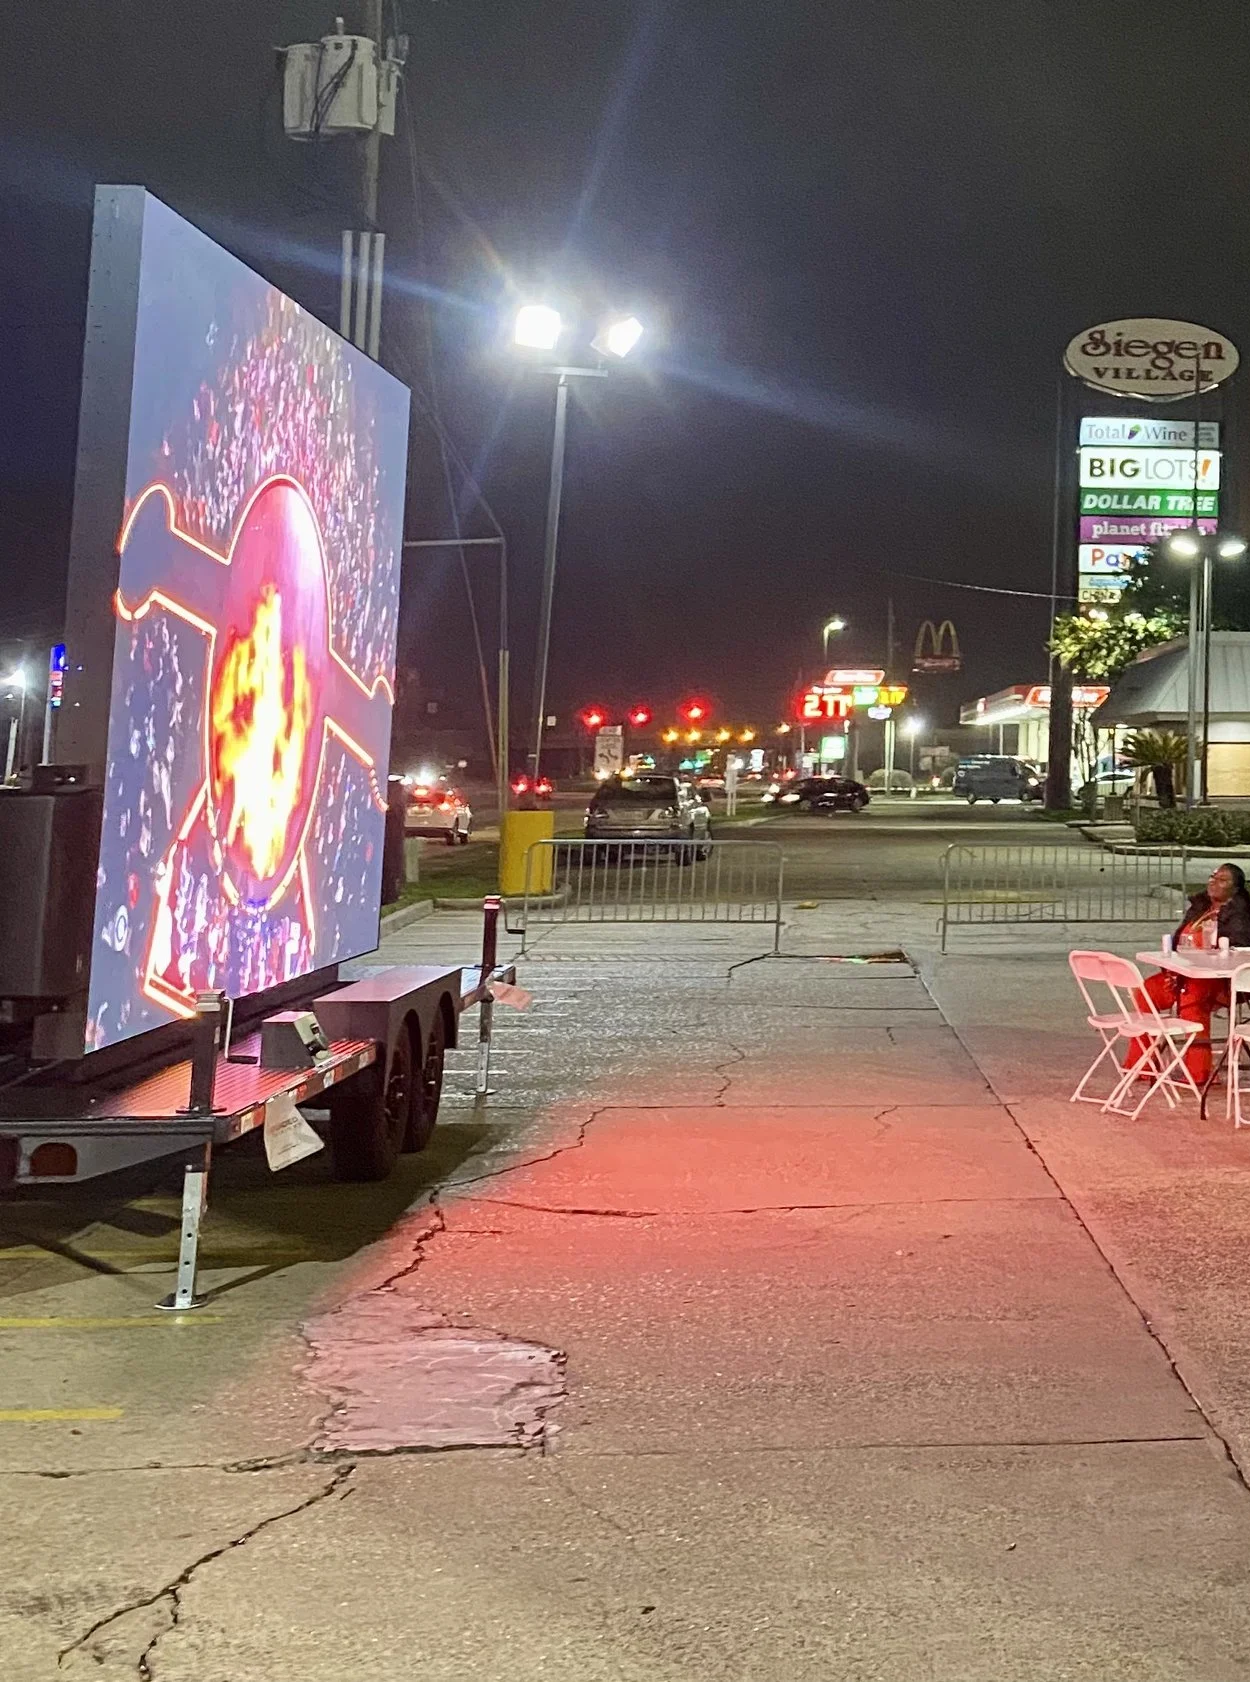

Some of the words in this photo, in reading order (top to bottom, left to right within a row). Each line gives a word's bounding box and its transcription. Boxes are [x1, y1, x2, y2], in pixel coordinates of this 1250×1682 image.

[1081, 329, 1225, 370] Siegen
[1094, 366, 1214, 382] VILLAGE
[1086, 423, 1126, 439] Total
[1144, 425, 1188, 441] Wine
[1089, 457, 1140, 478] BIG
[1145, 458, 1212, 481] LOTS!
[1083, 494, 1161, 511] DOLLAR
[1092, 520, 1146, 538] planet
